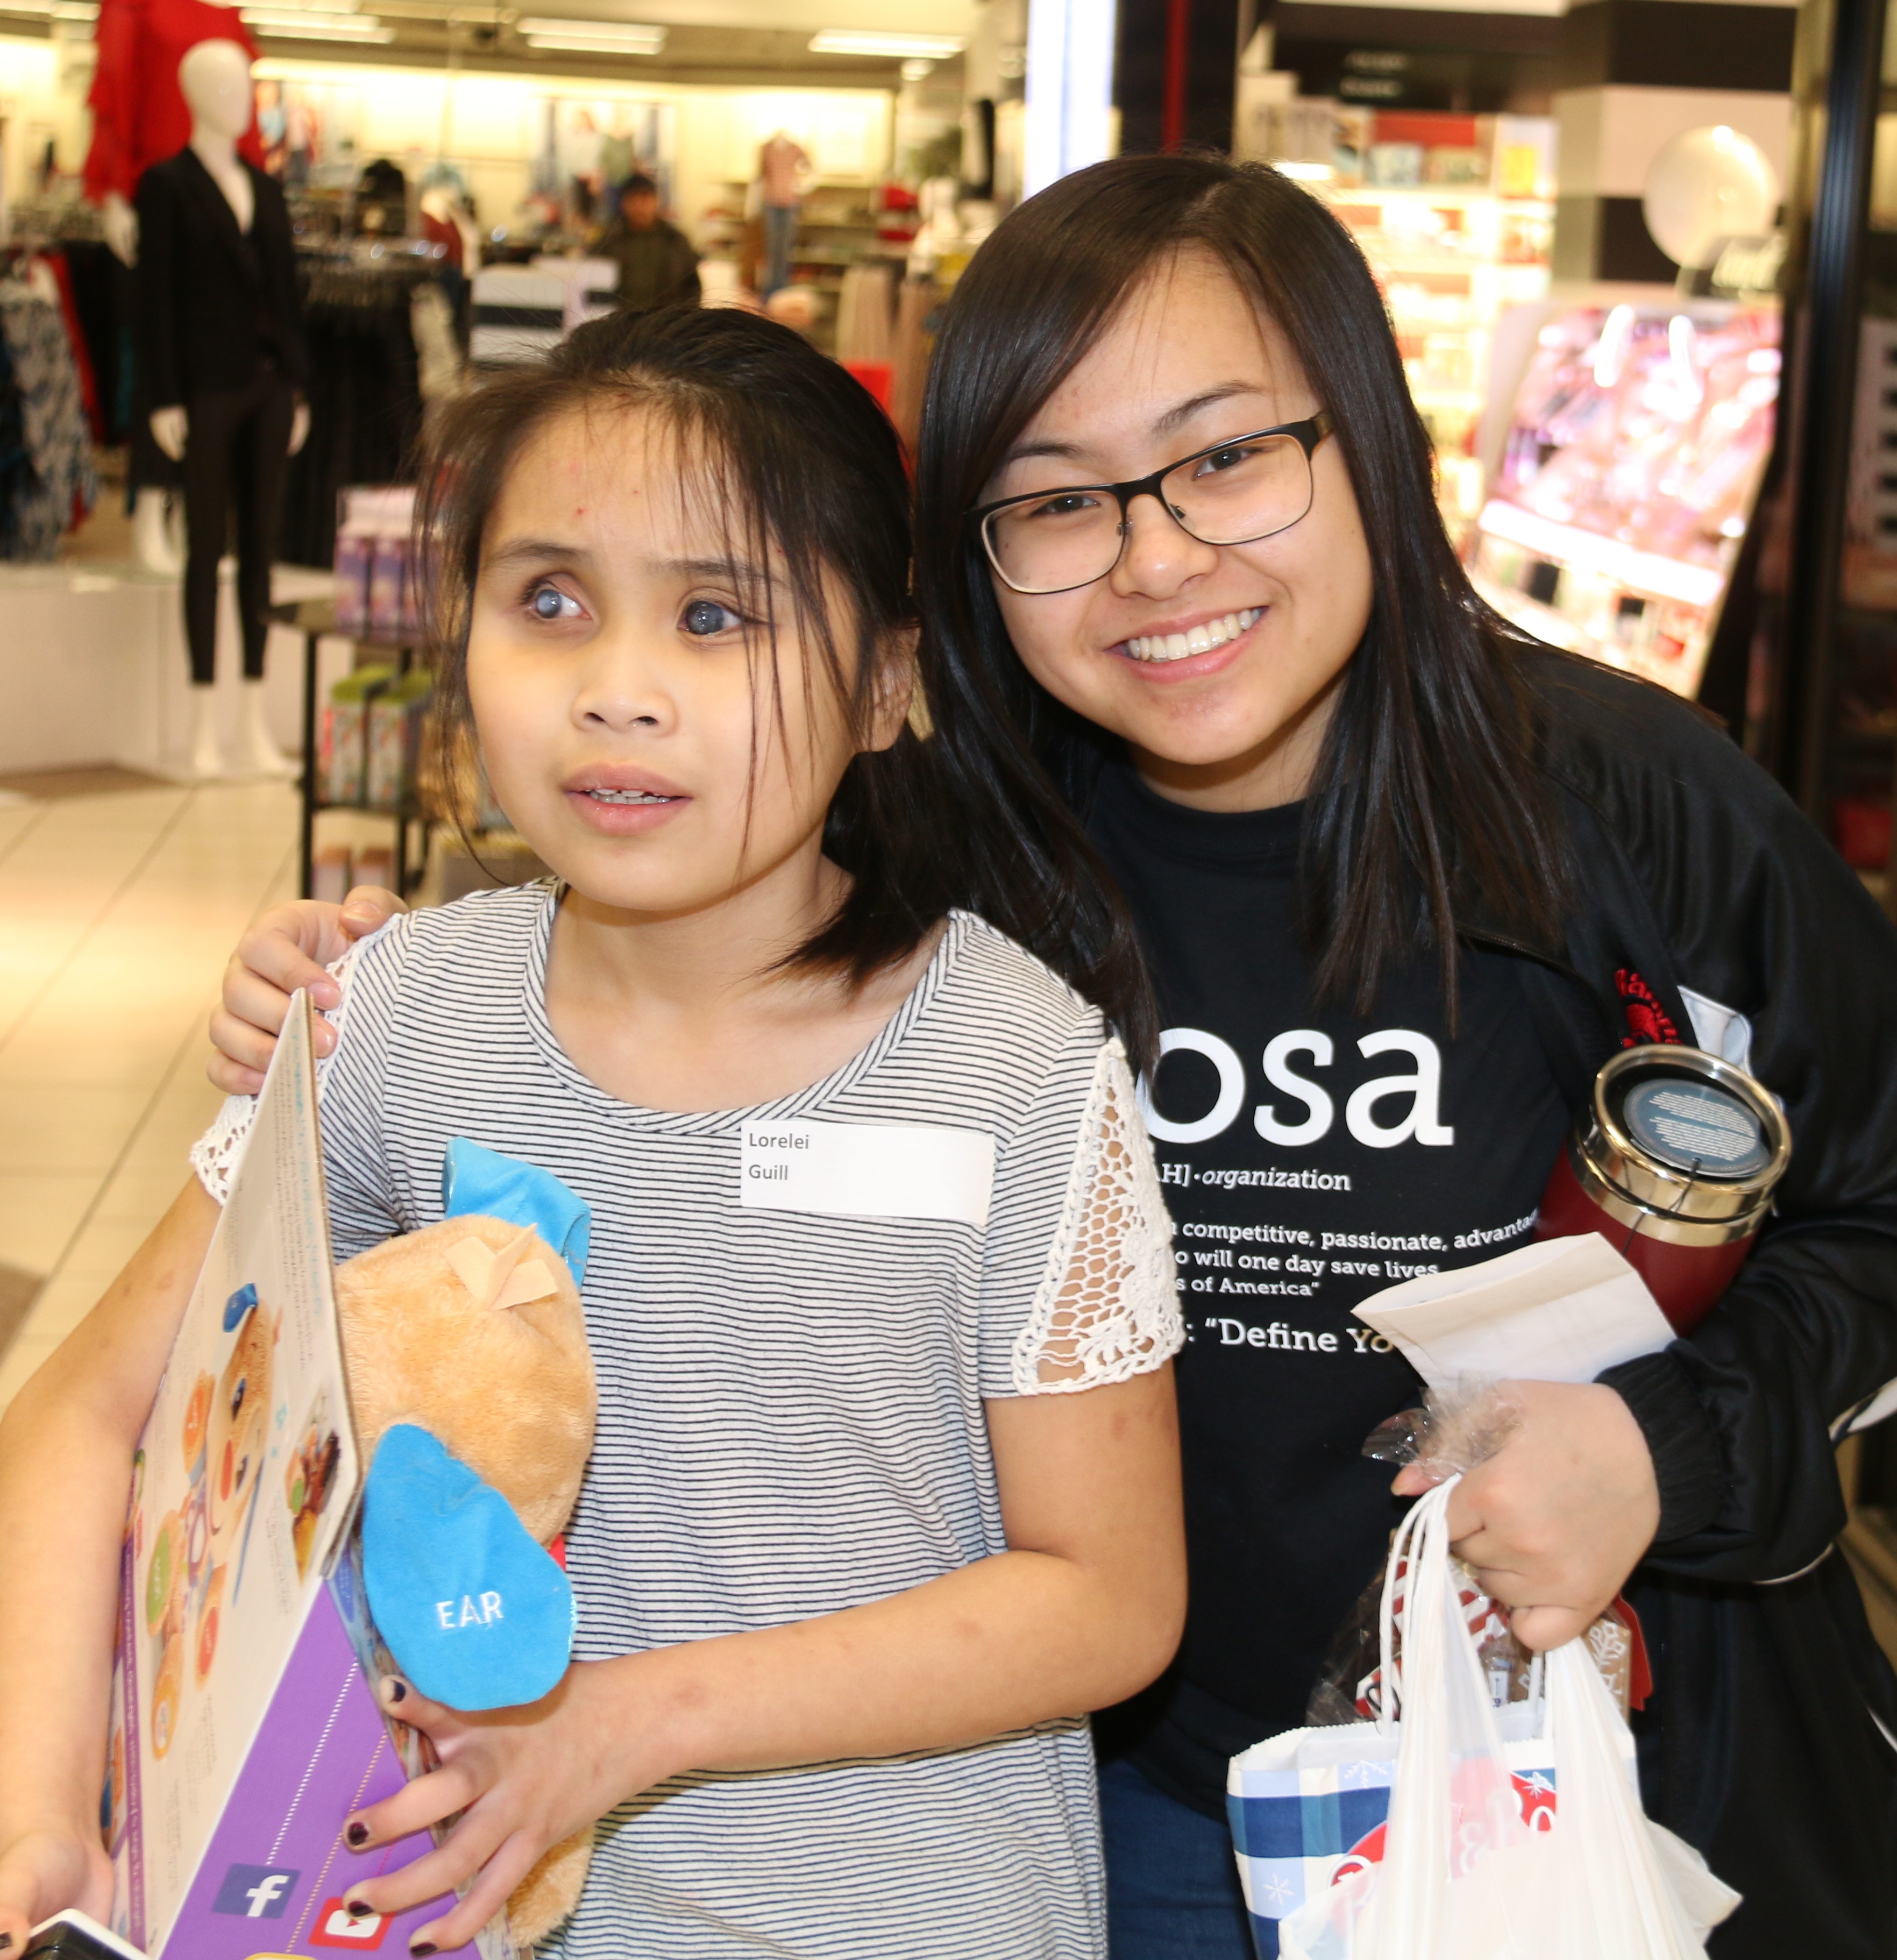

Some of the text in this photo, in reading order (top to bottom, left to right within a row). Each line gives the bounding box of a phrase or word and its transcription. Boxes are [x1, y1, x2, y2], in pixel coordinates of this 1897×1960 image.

[749, 1133, 809, 1149] Lorelei
[748, 1164, 788, 1180] Guill
[1182, 1223, 1316, 1247] competitive,
[1320, 1232, 1448, 1252] passionate,
[1194, 1250, 1233, 1268] will
[1238, 1254, 1280, 1271] one
[1285, 1255, 1326, 1277] day
[1331, 1261, 1380, 1277] save
[1384, 1261, 1439, 1279] lives
[1191, 1276, 1215, 1292] of
[436, 1590, 504, 1629] EAR
